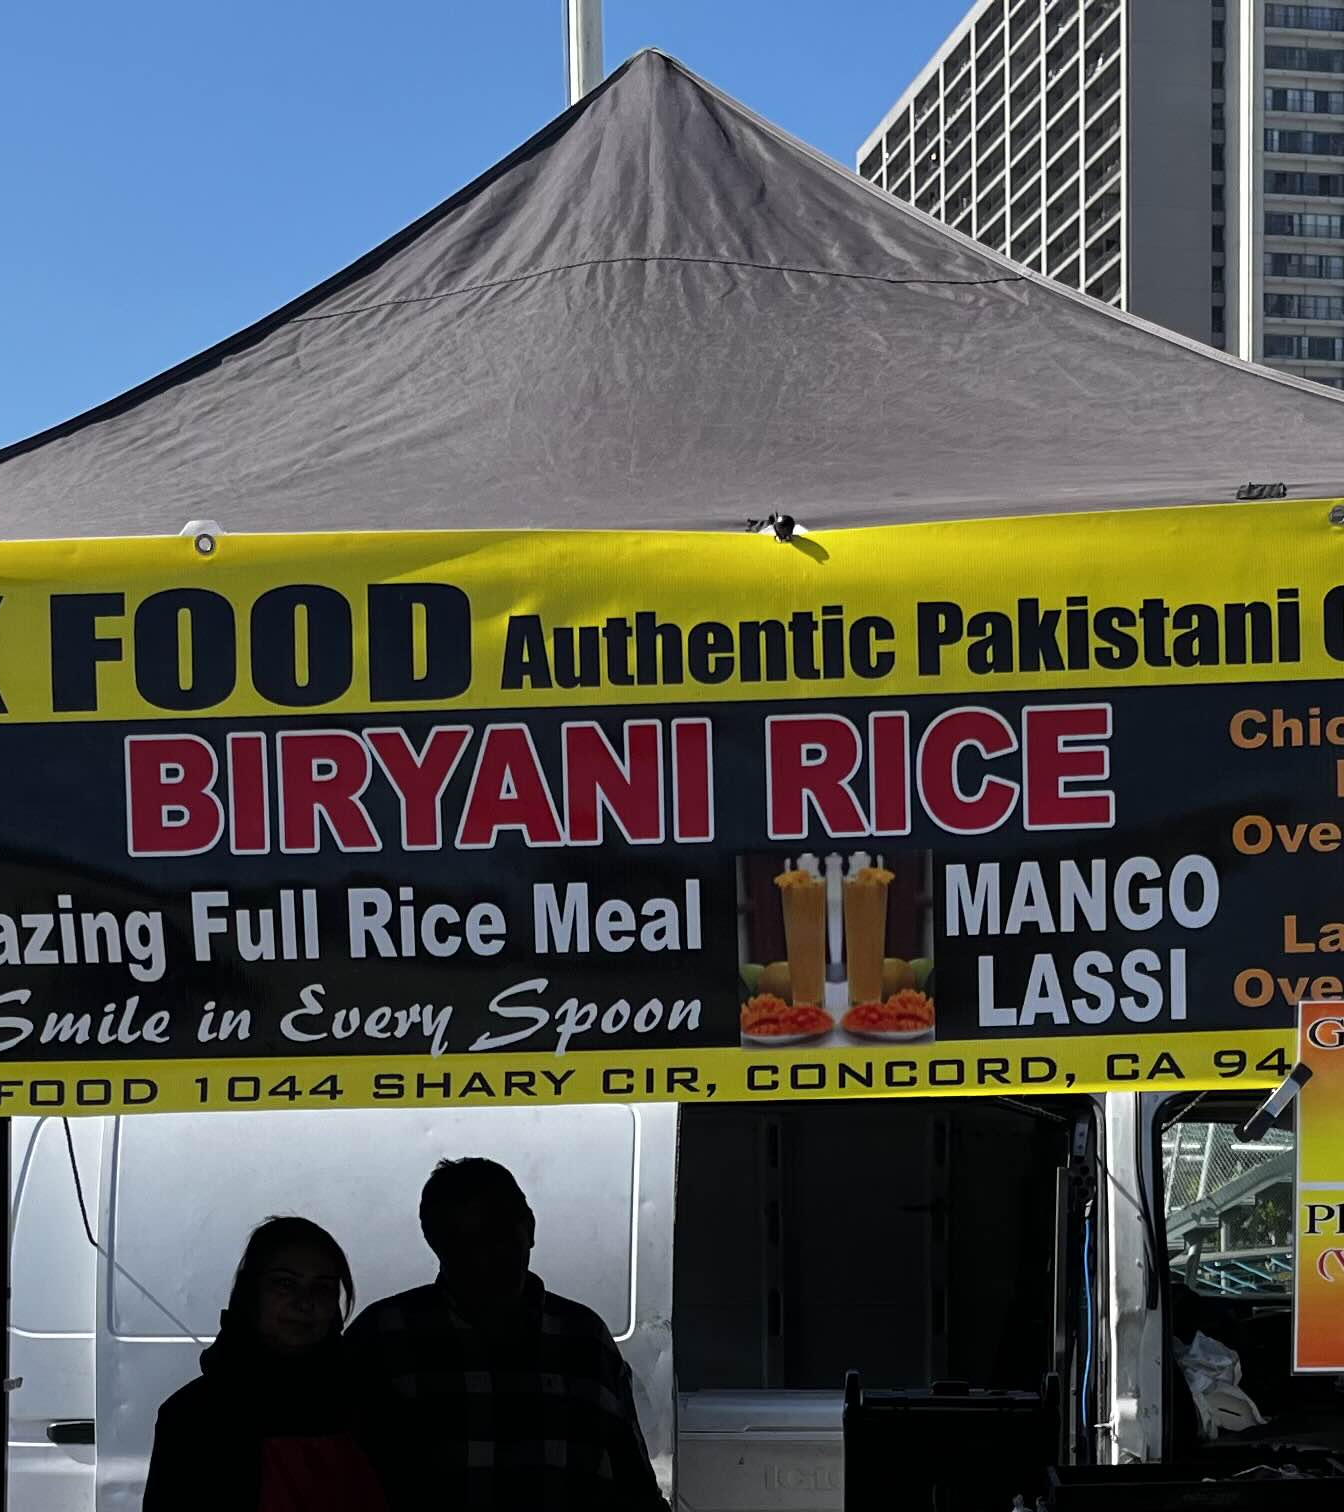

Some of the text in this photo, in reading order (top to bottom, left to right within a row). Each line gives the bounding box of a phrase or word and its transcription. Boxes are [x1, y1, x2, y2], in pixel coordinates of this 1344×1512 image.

[51, 584, 472, 712] FOOD
[501, 604, 895, 690] Authentic
[917, 588, 1301, 676] Pakistani
[123, 704, 1115, 858] BIRYANI RICE
[191, 889, 319, 962] Full
[347, 887, 507, 959] Rice
[533, 878, 702, 954] Meal
[945, 854, 1220, 937] MANGO
[197, 1001, 251, 1043] in
[279, 984, 454, 1057] Every
[469, 978, 702, 1056] Spoon
[977, 948, 1187, 1028] LASSI
[194, 1075, 344, 1104] 1044
[373, 1069, 576, 1099] SHARY
[602, 1067, 716, 1097] CIR,
[746, 1056, 1076, 1091] CONCORD,
[1107, 1052, 1186, 1080] CA
